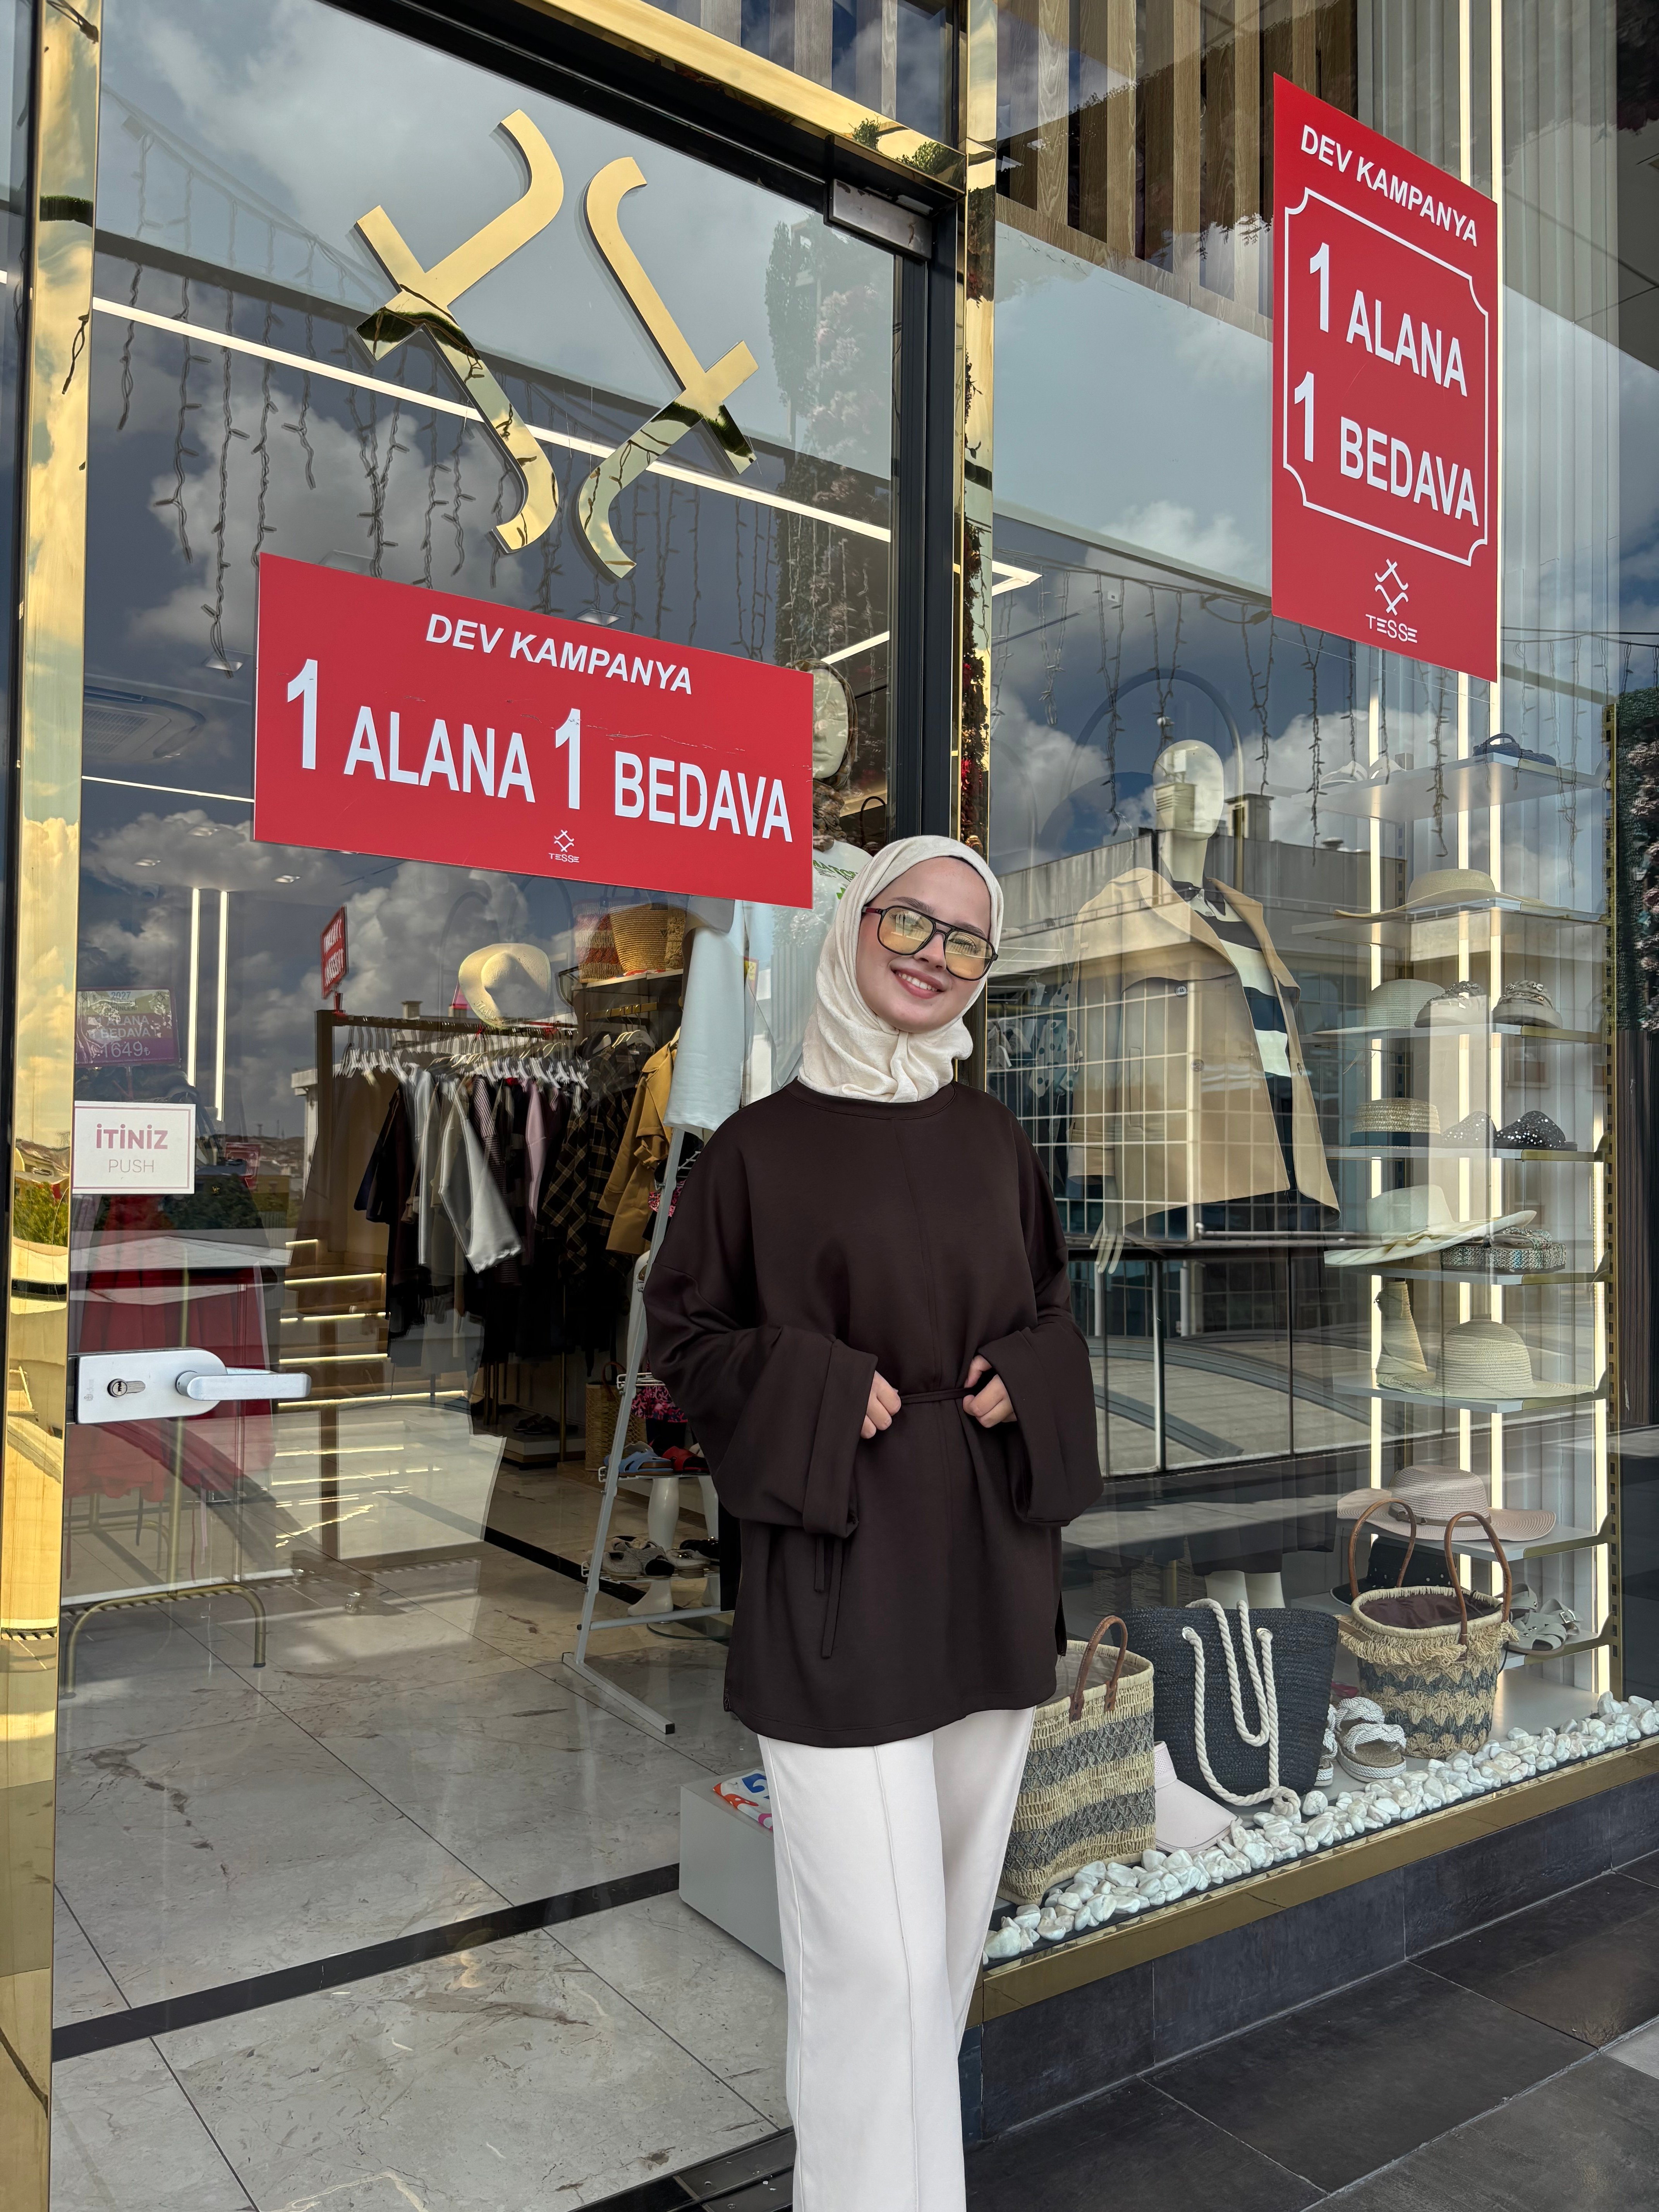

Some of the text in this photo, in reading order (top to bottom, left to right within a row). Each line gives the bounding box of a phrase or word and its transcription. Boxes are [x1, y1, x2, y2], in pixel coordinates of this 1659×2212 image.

[1301, 124, 1477, 247] DEV KAMPANYA
[1310, 242, 1467, 397] 1 ALANA
[1294, 371, 1479, 527] 1 BEDAVA
[1365, 614, 1417, 643] TESSE
[426, 613, 692, 695] DEV KAMPANYA
[287, 659, 793, 843] 1 ALANA 1 BEDAVA
[548, 853, 580, 863] TESSE
[100, 1027, 151, 1038] BEDAVA
[107, 1015, 149, 1026] ALANA
[96, 1123, 168, 1149] İTİNİZ
[109, 1159, 154, 1173] PUSH
